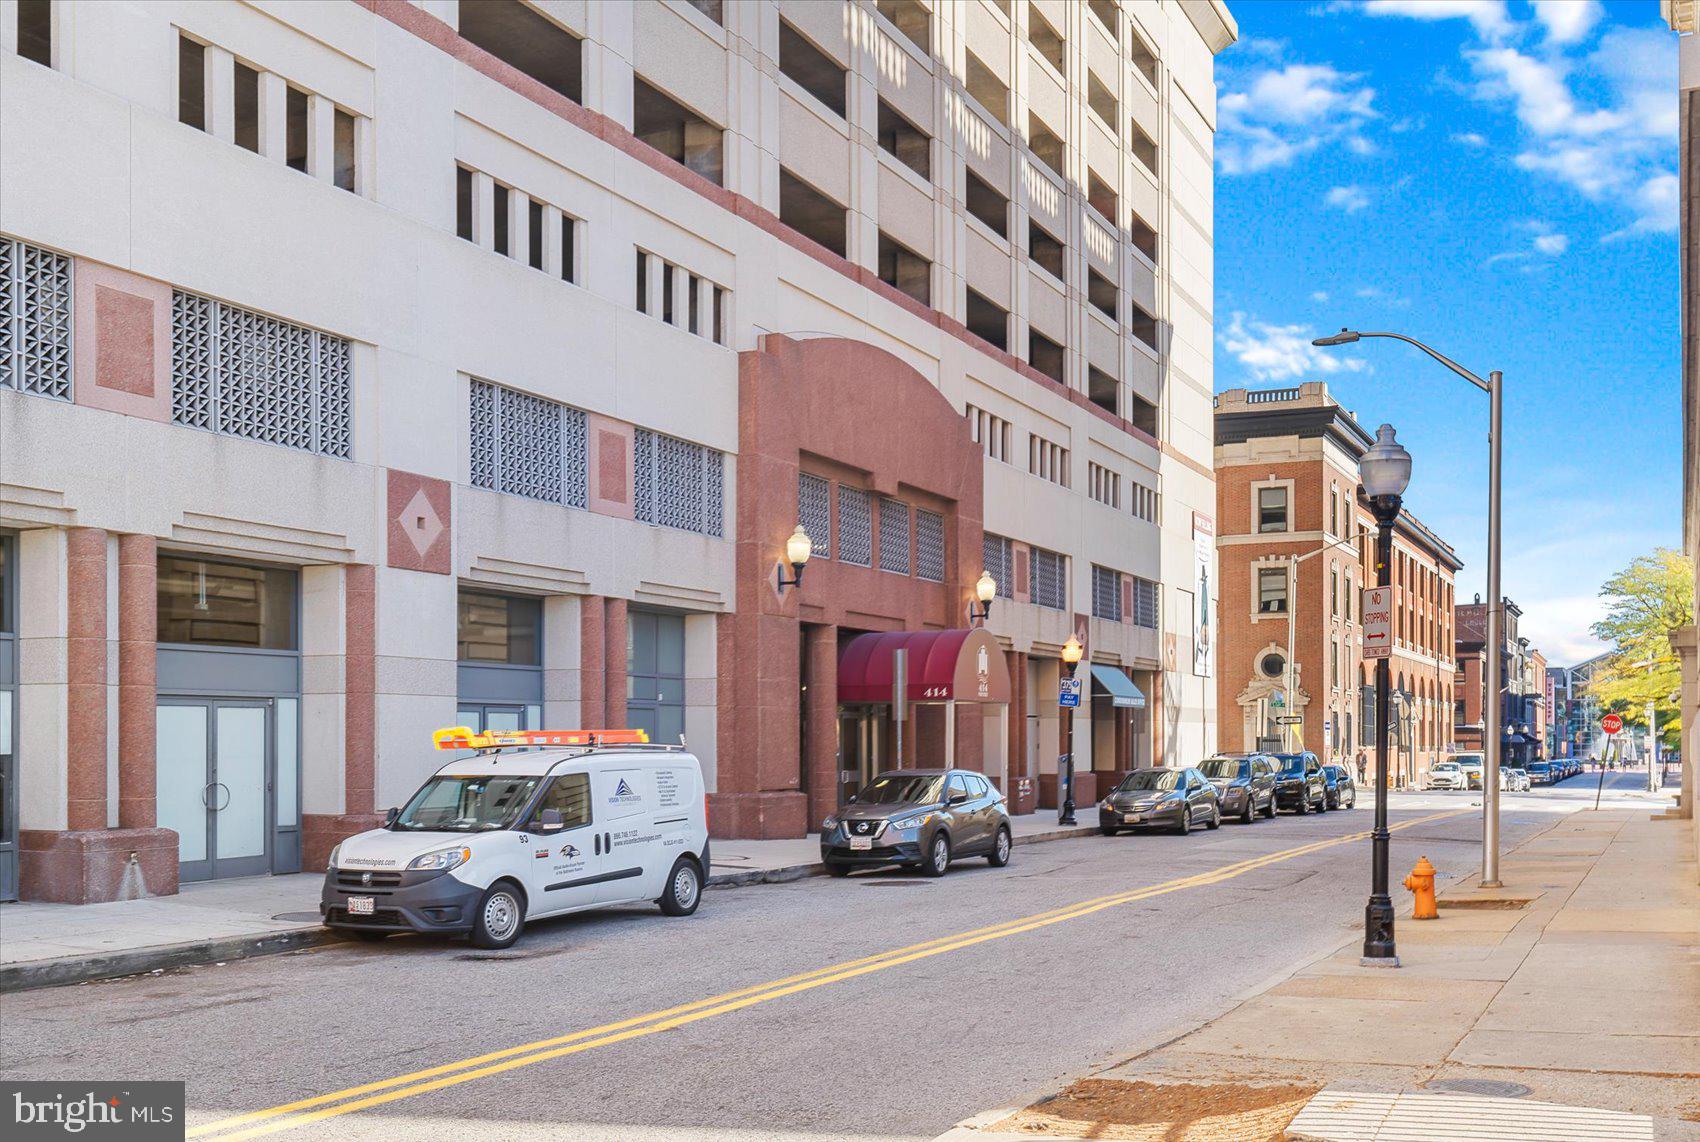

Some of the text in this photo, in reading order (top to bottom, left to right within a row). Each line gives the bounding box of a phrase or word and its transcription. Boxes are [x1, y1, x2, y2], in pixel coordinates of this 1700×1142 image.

[1372, 592, 1381, 605] NO
[1365, 611, 1389, 625] STOPPING
[923, 687, 948, 697] 414
[1603, 720, 1621, 729] STOP
[519, 835, 529, 843] 93
